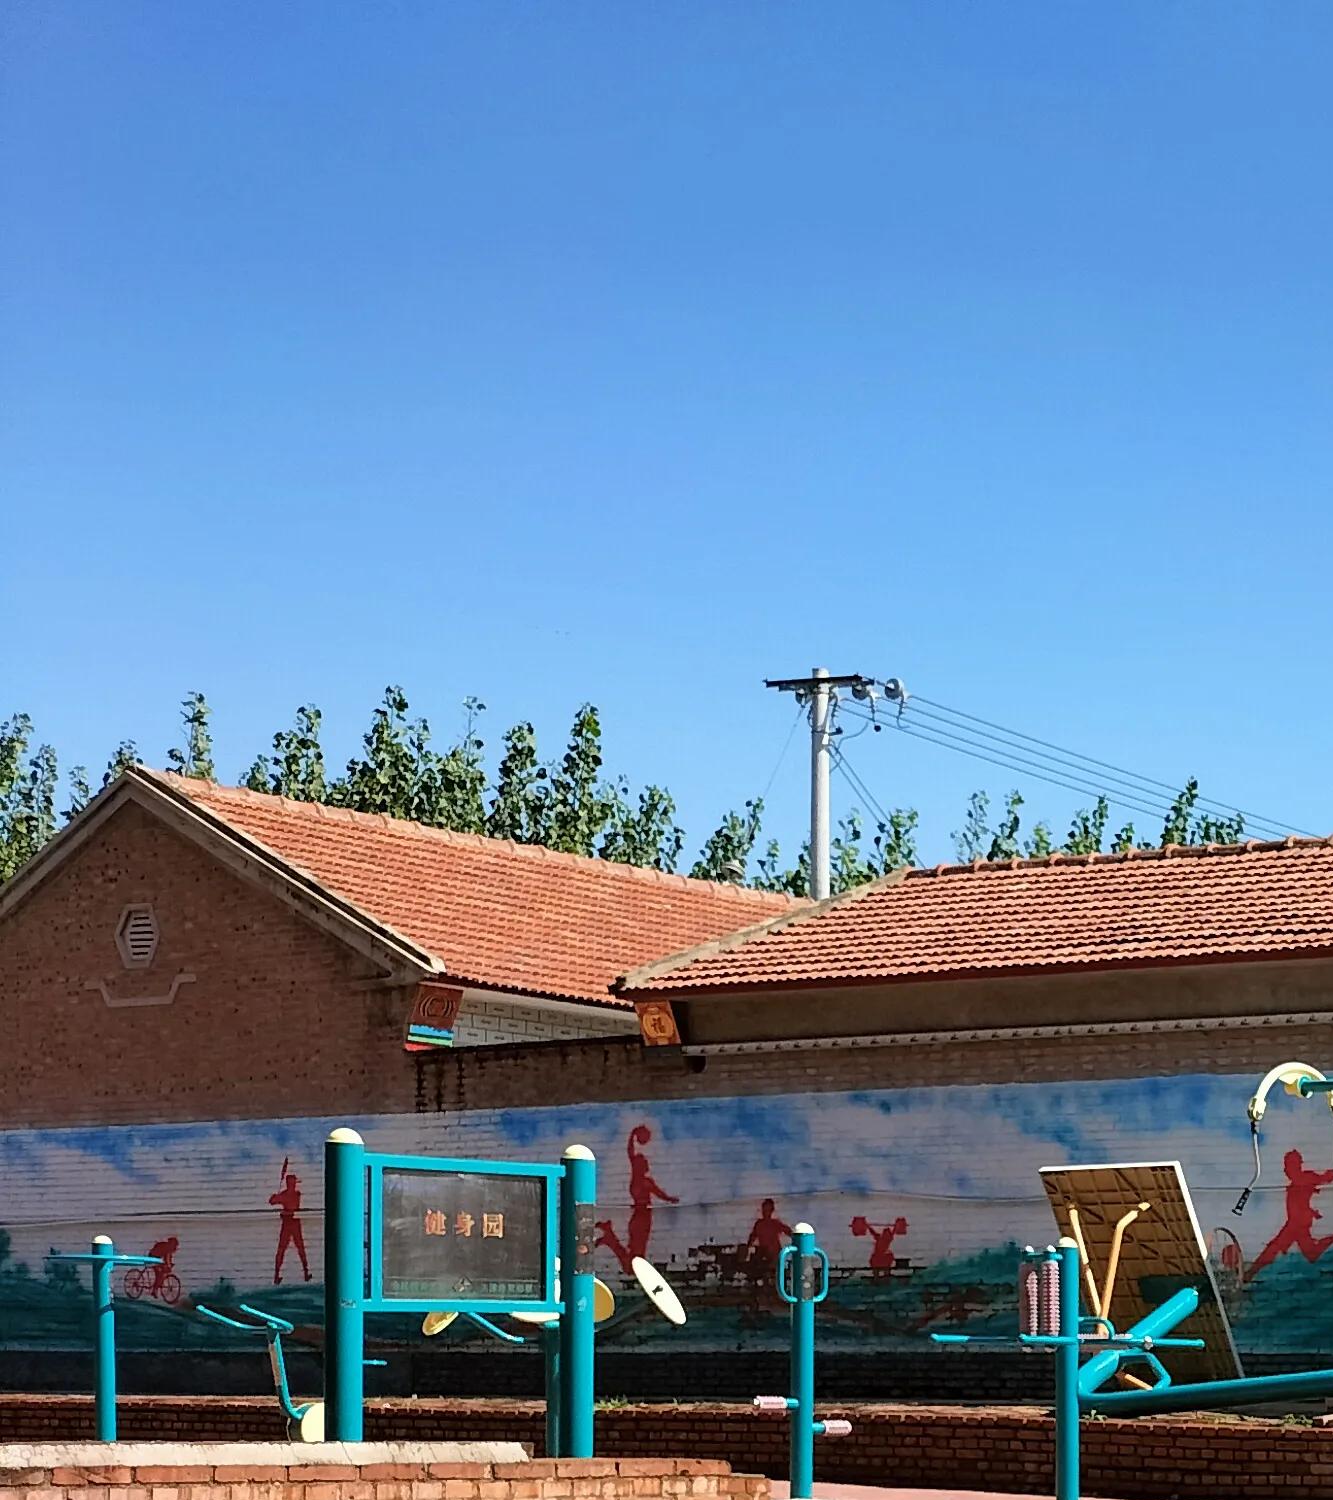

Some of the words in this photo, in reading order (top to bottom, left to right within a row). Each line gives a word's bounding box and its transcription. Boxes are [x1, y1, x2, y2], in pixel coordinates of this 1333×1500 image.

[649, 1016, 666, 1035] 福
[424, 1209, 504, 1238] 健身园
